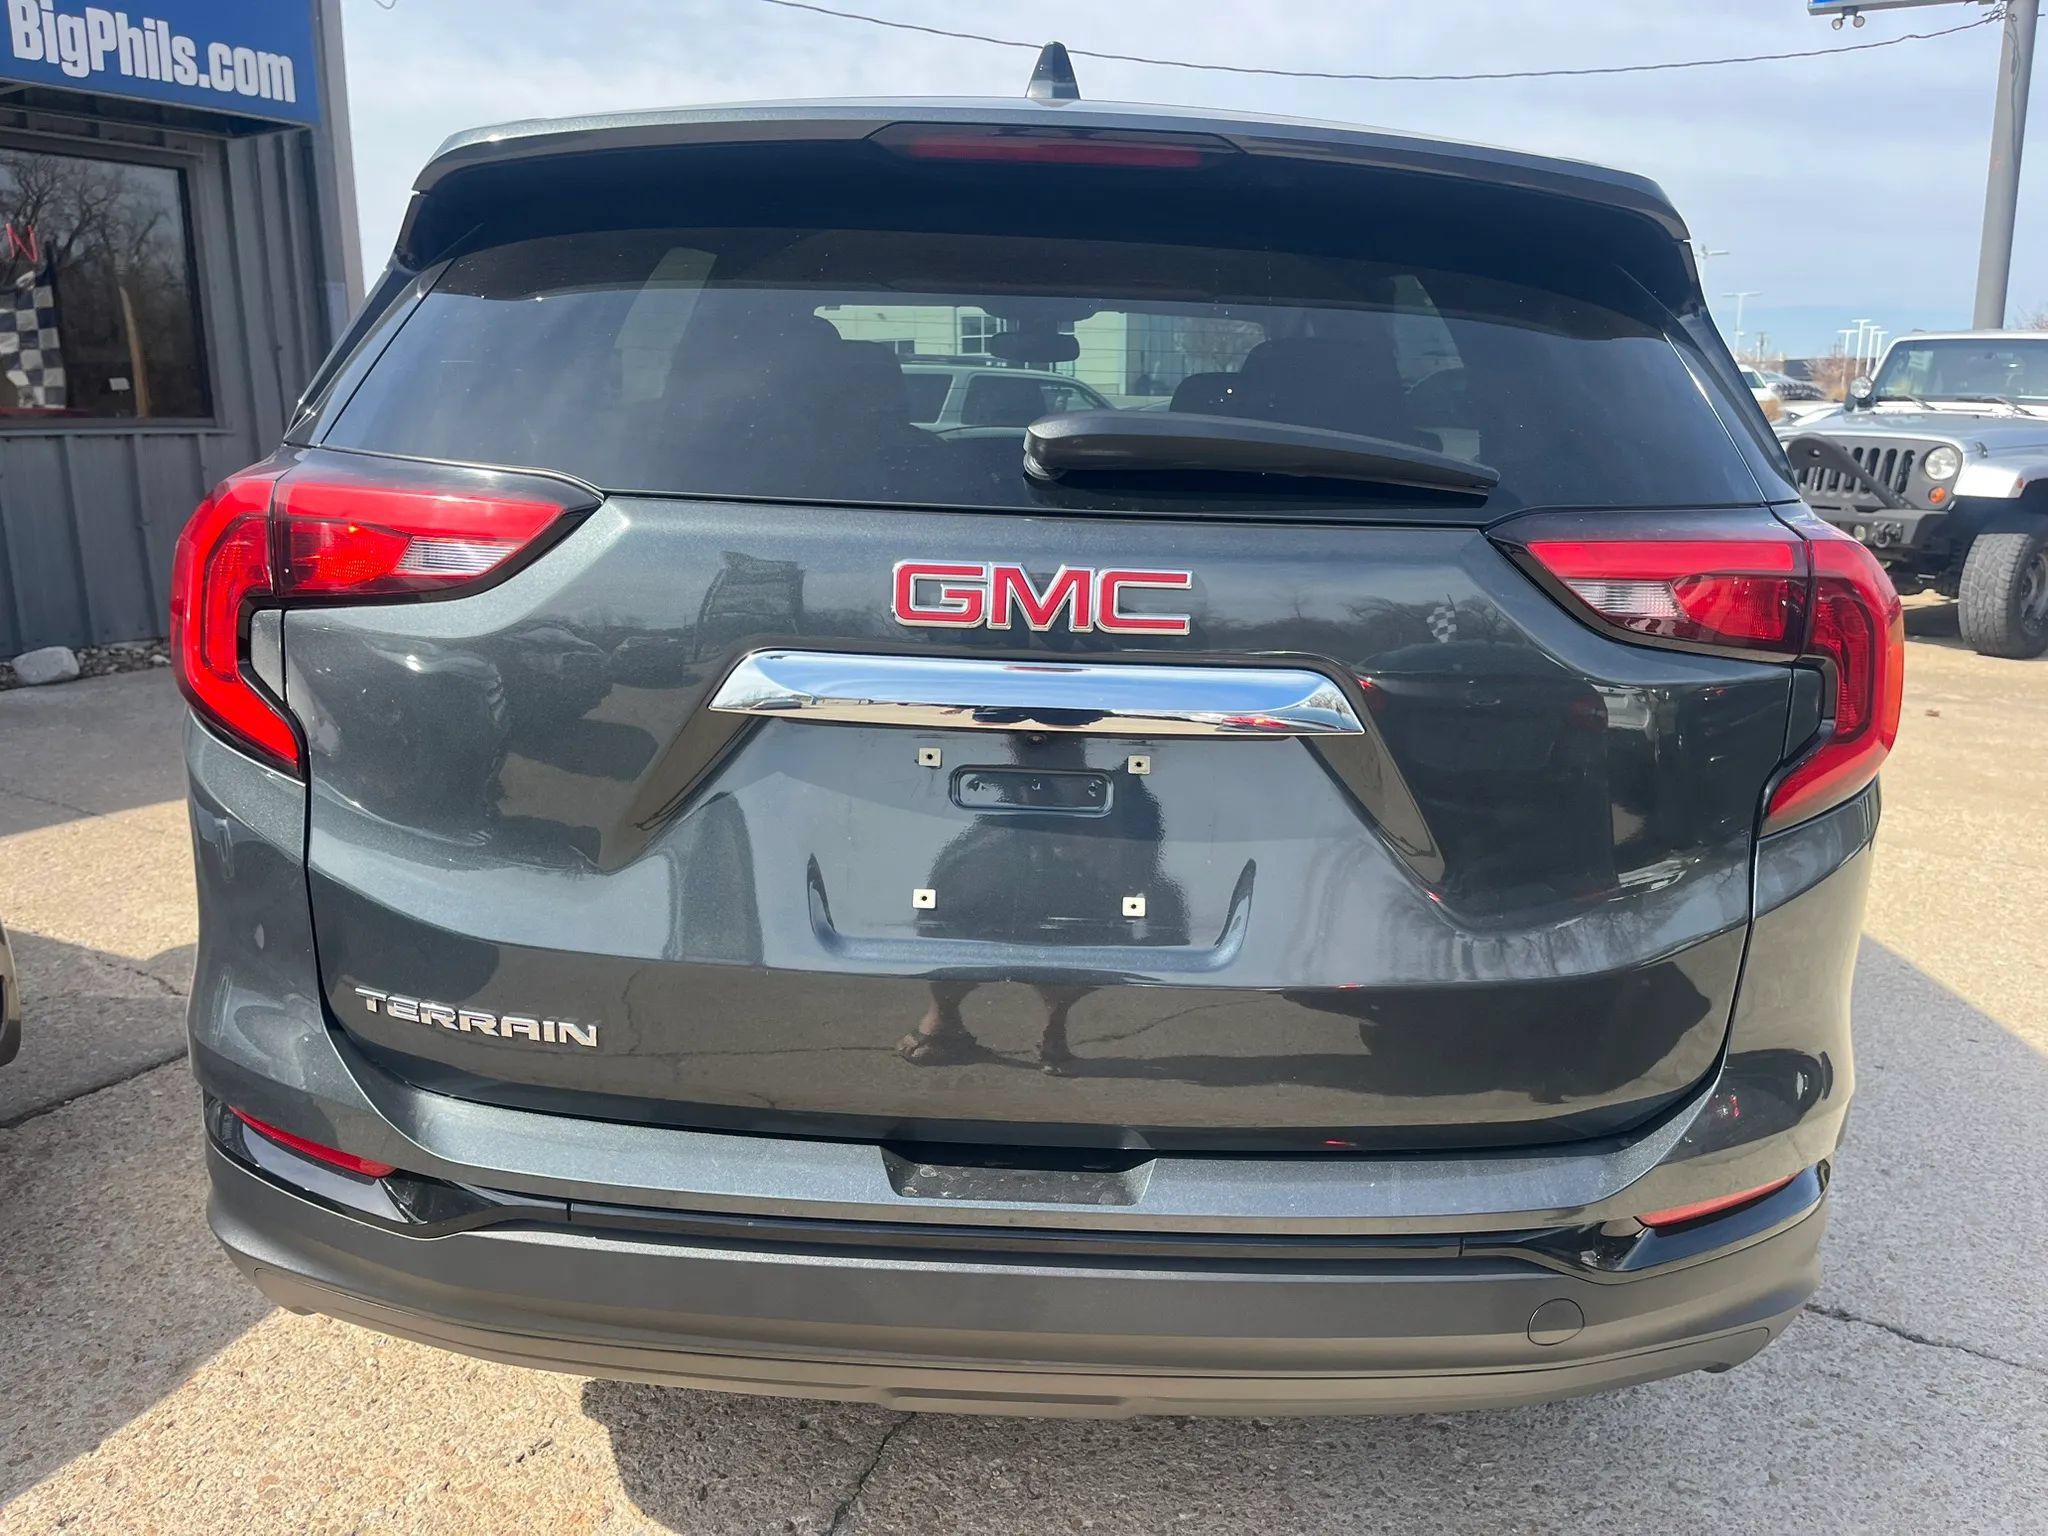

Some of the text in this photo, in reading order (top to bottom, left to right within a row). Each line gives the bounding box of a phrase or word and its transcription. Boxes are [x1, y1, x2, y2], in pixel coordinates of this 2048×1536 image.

[7, 0, 296, 103] BigPhils.com
[892, 559, 1193, 636] GMC
[355, 985, 598, 1048] TERRAIN
